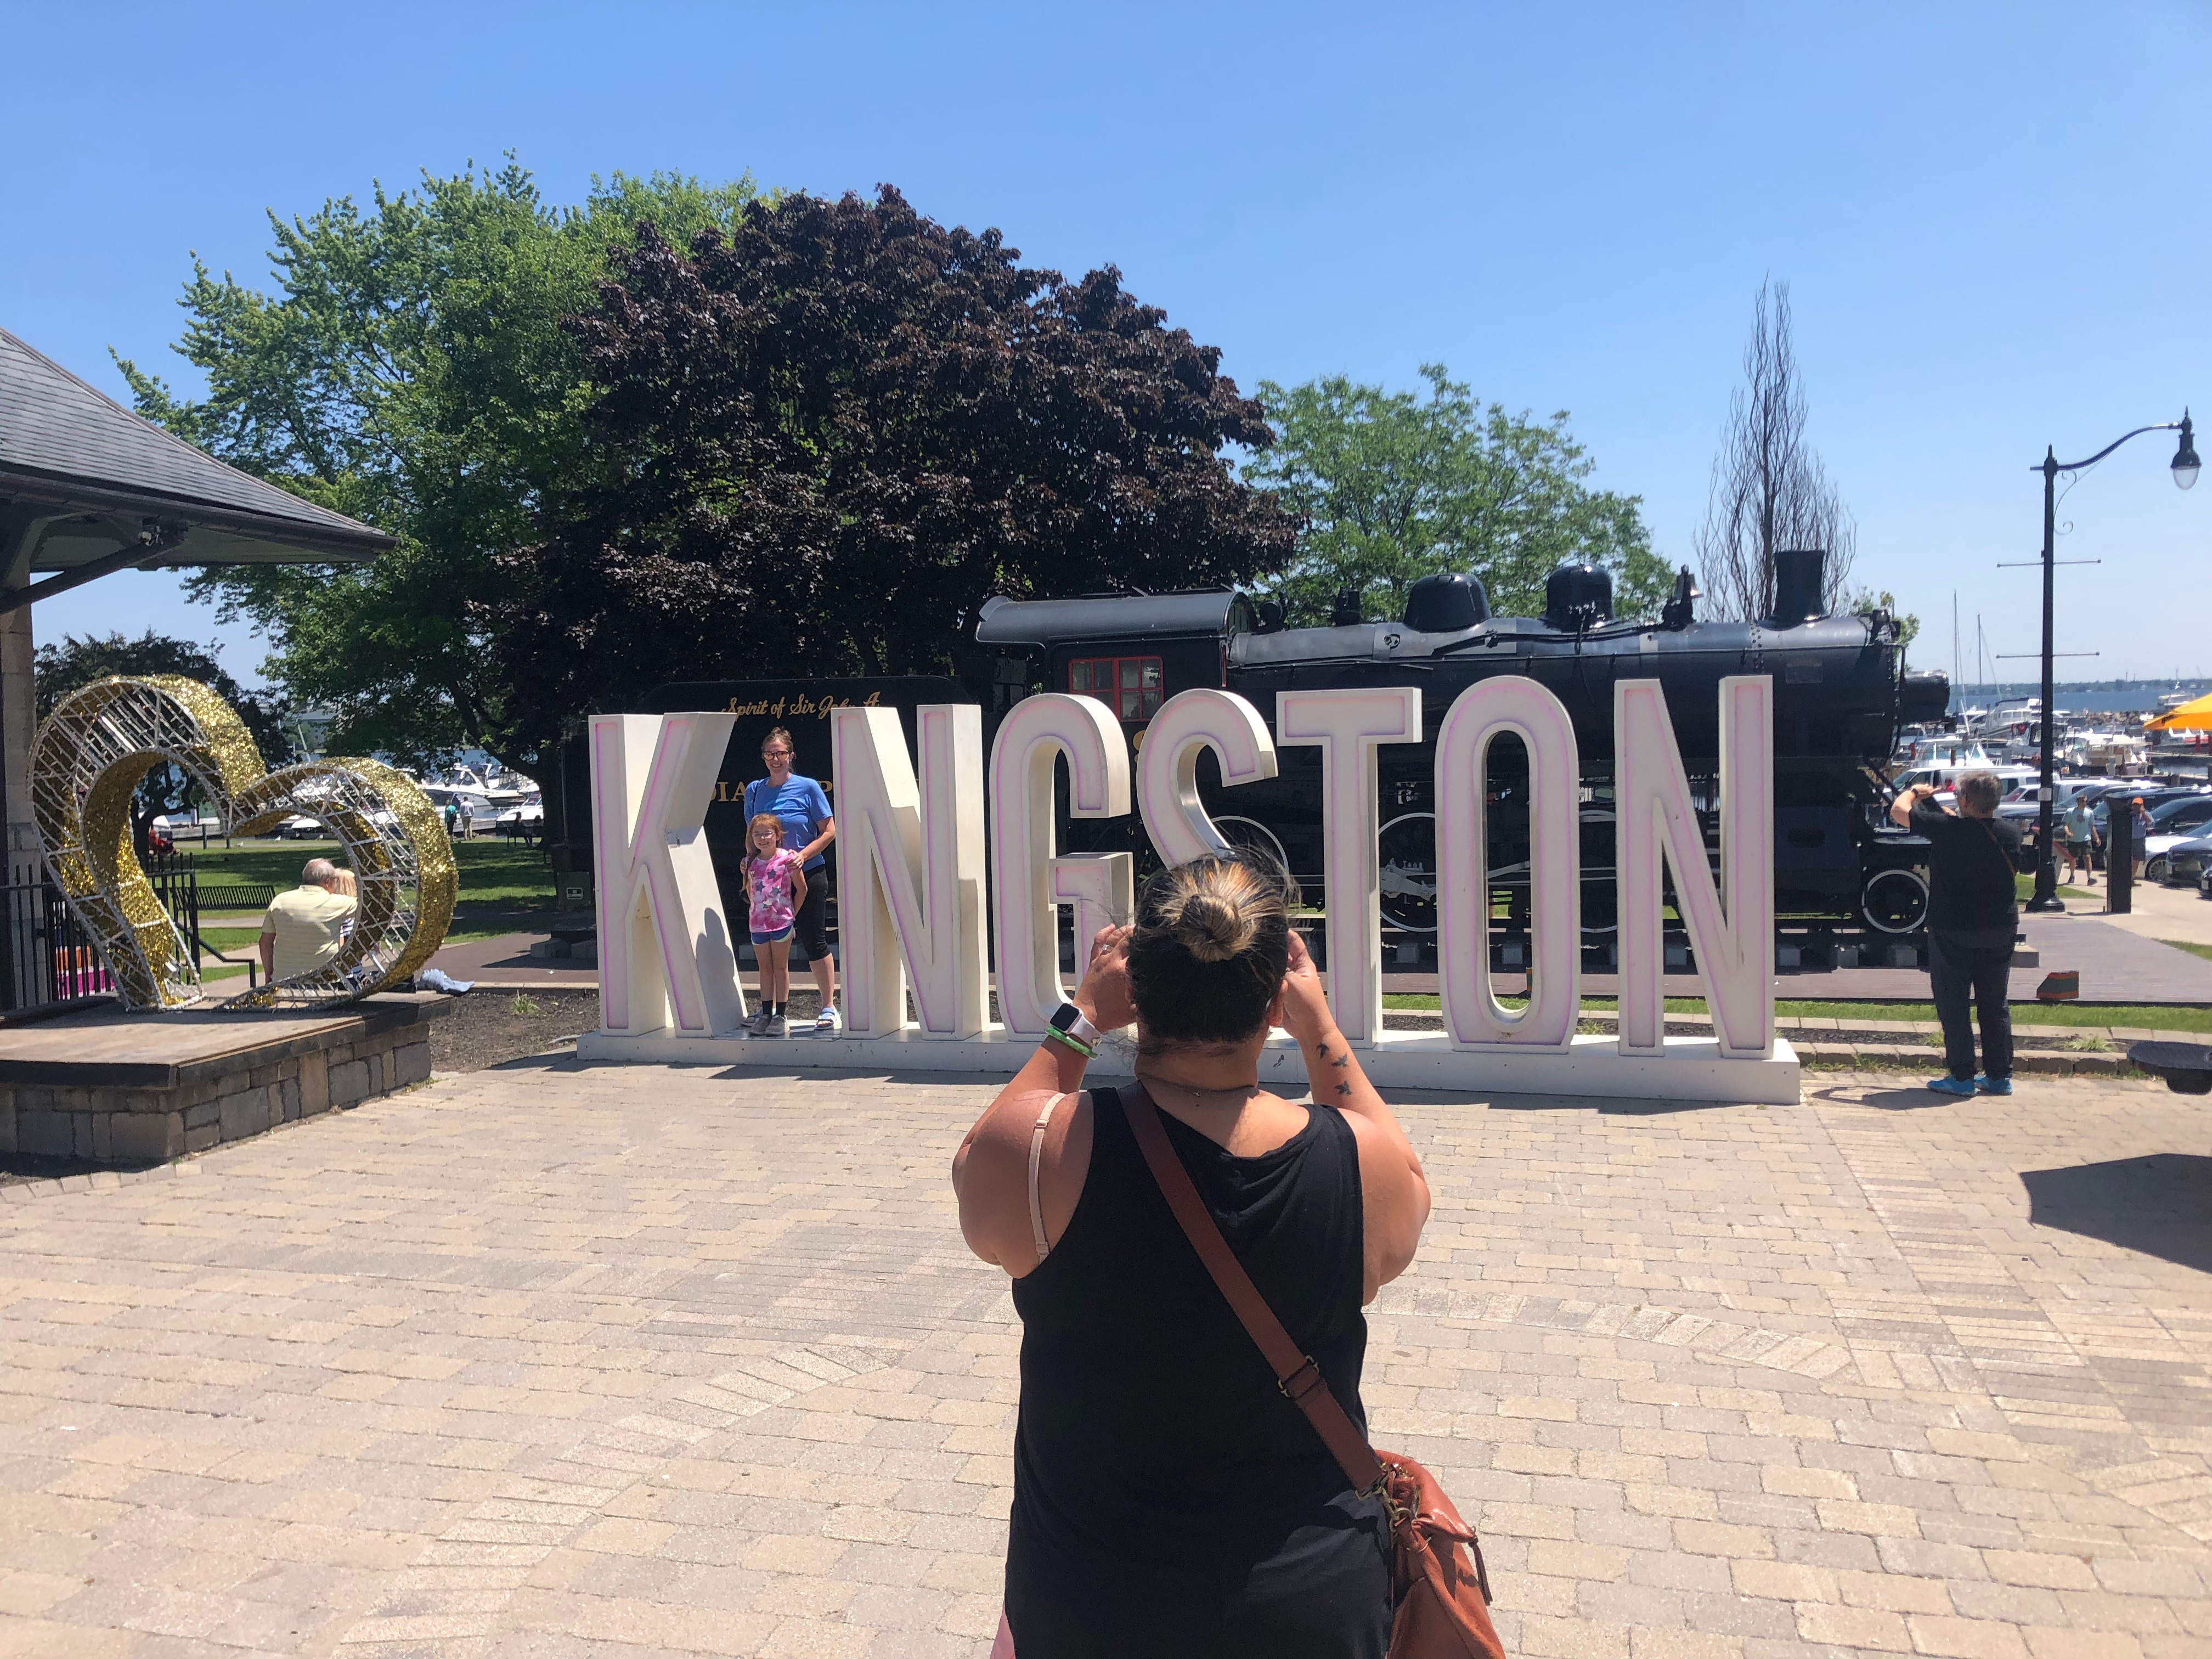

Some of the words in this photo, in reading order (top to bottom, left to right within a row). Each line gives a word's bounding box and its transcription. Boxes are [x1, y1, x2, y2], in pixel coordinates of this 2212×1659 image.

[721, 697, 769, 722] Spirit
[770, 697, 786, 719] of
[789, 693, 816, 715] Sir
[818, 695, 855, 720] Jh
